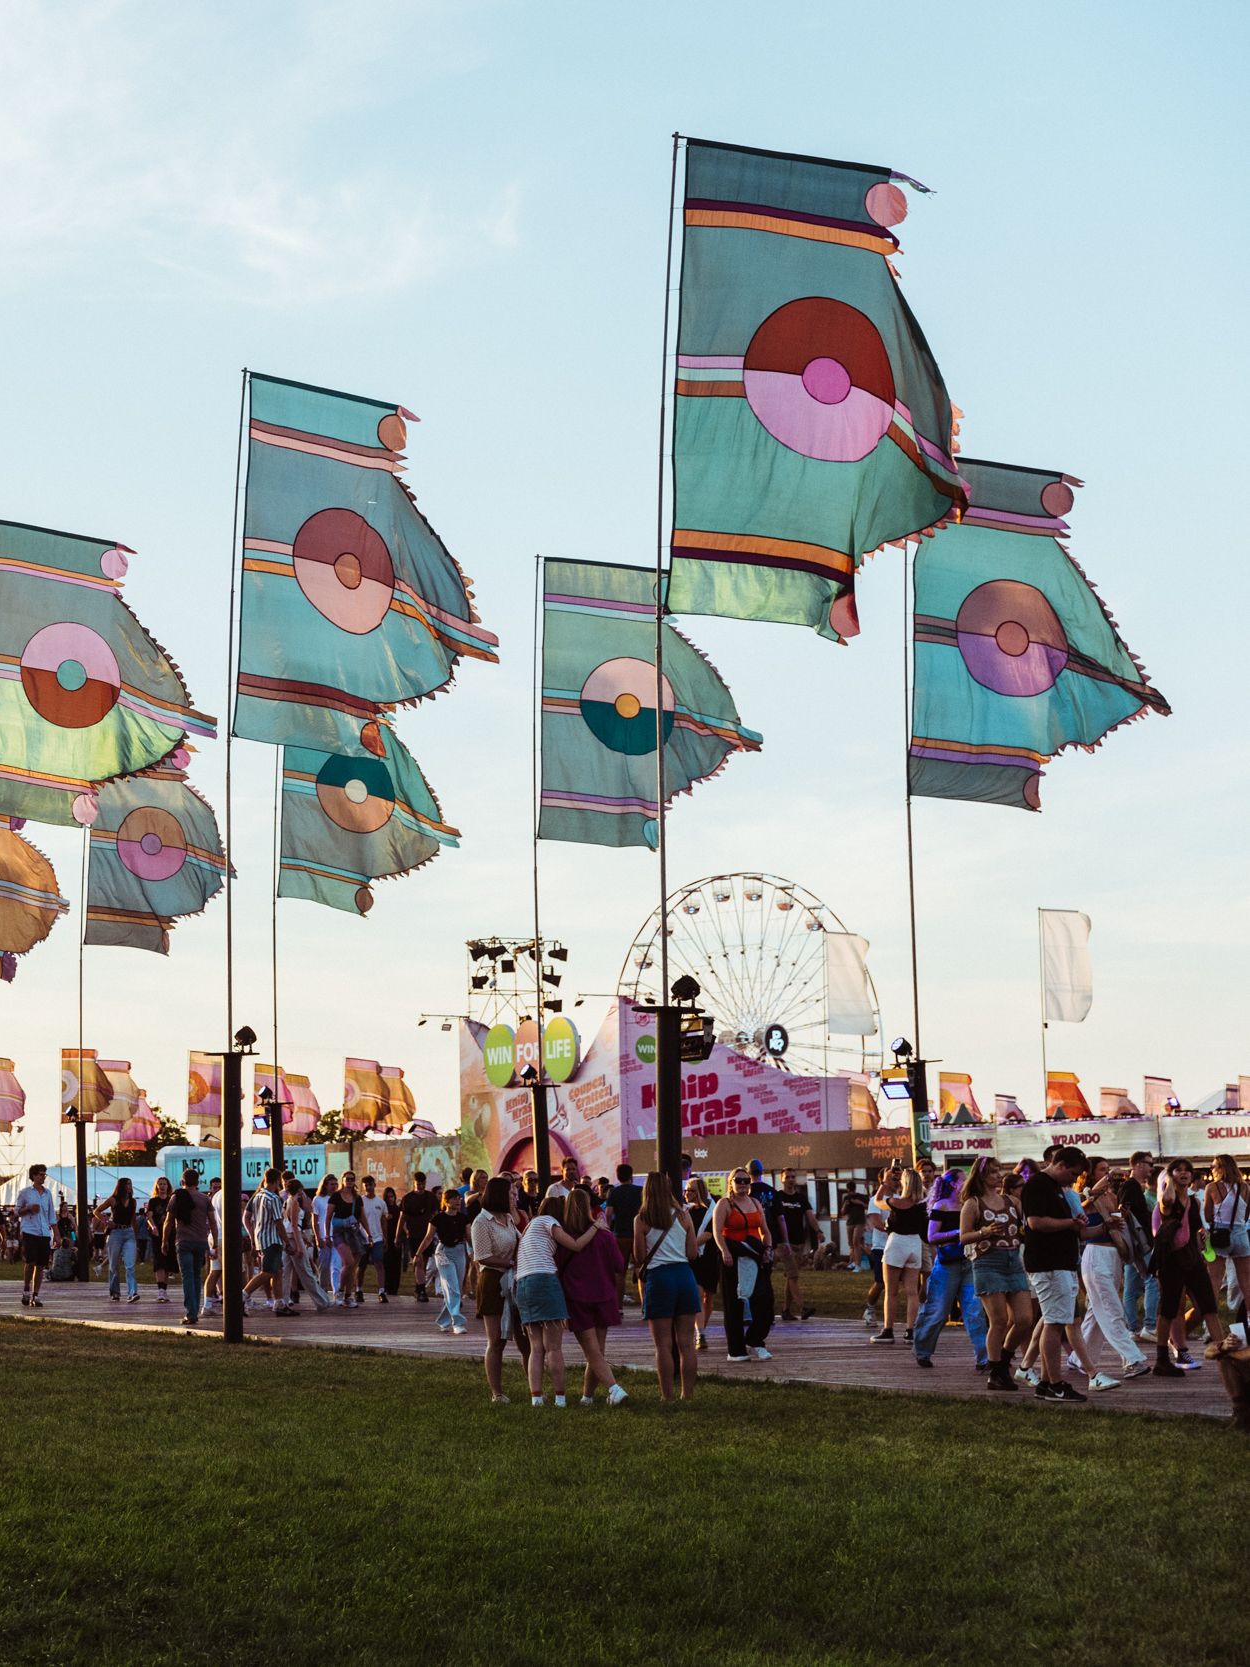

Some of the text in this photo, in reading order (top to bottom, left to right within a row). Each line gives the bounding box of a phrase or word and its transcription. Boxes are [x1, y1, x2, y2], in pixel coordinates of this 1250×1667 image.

[487, 1046, 512, 1066] WIN
[545, 1038, 572, 1059] LIFE
[641, 1073, 718, 1110] Kip
[1052, 1133, 1101, 1146] WRAPIDO
[1207, 1127, 1250, 1139] SICILIA
[854, 1134, 913, 1148] CHARGE YOU
[930, 1138, 993, 1151] PULLED PORK
[787, 1145, 810, 1156] SHOP
[871, 1148, 905, 1159] PHONE
[246, 1161, 262, 1177] WE
[300, 1158, 319, 1175] LOT
